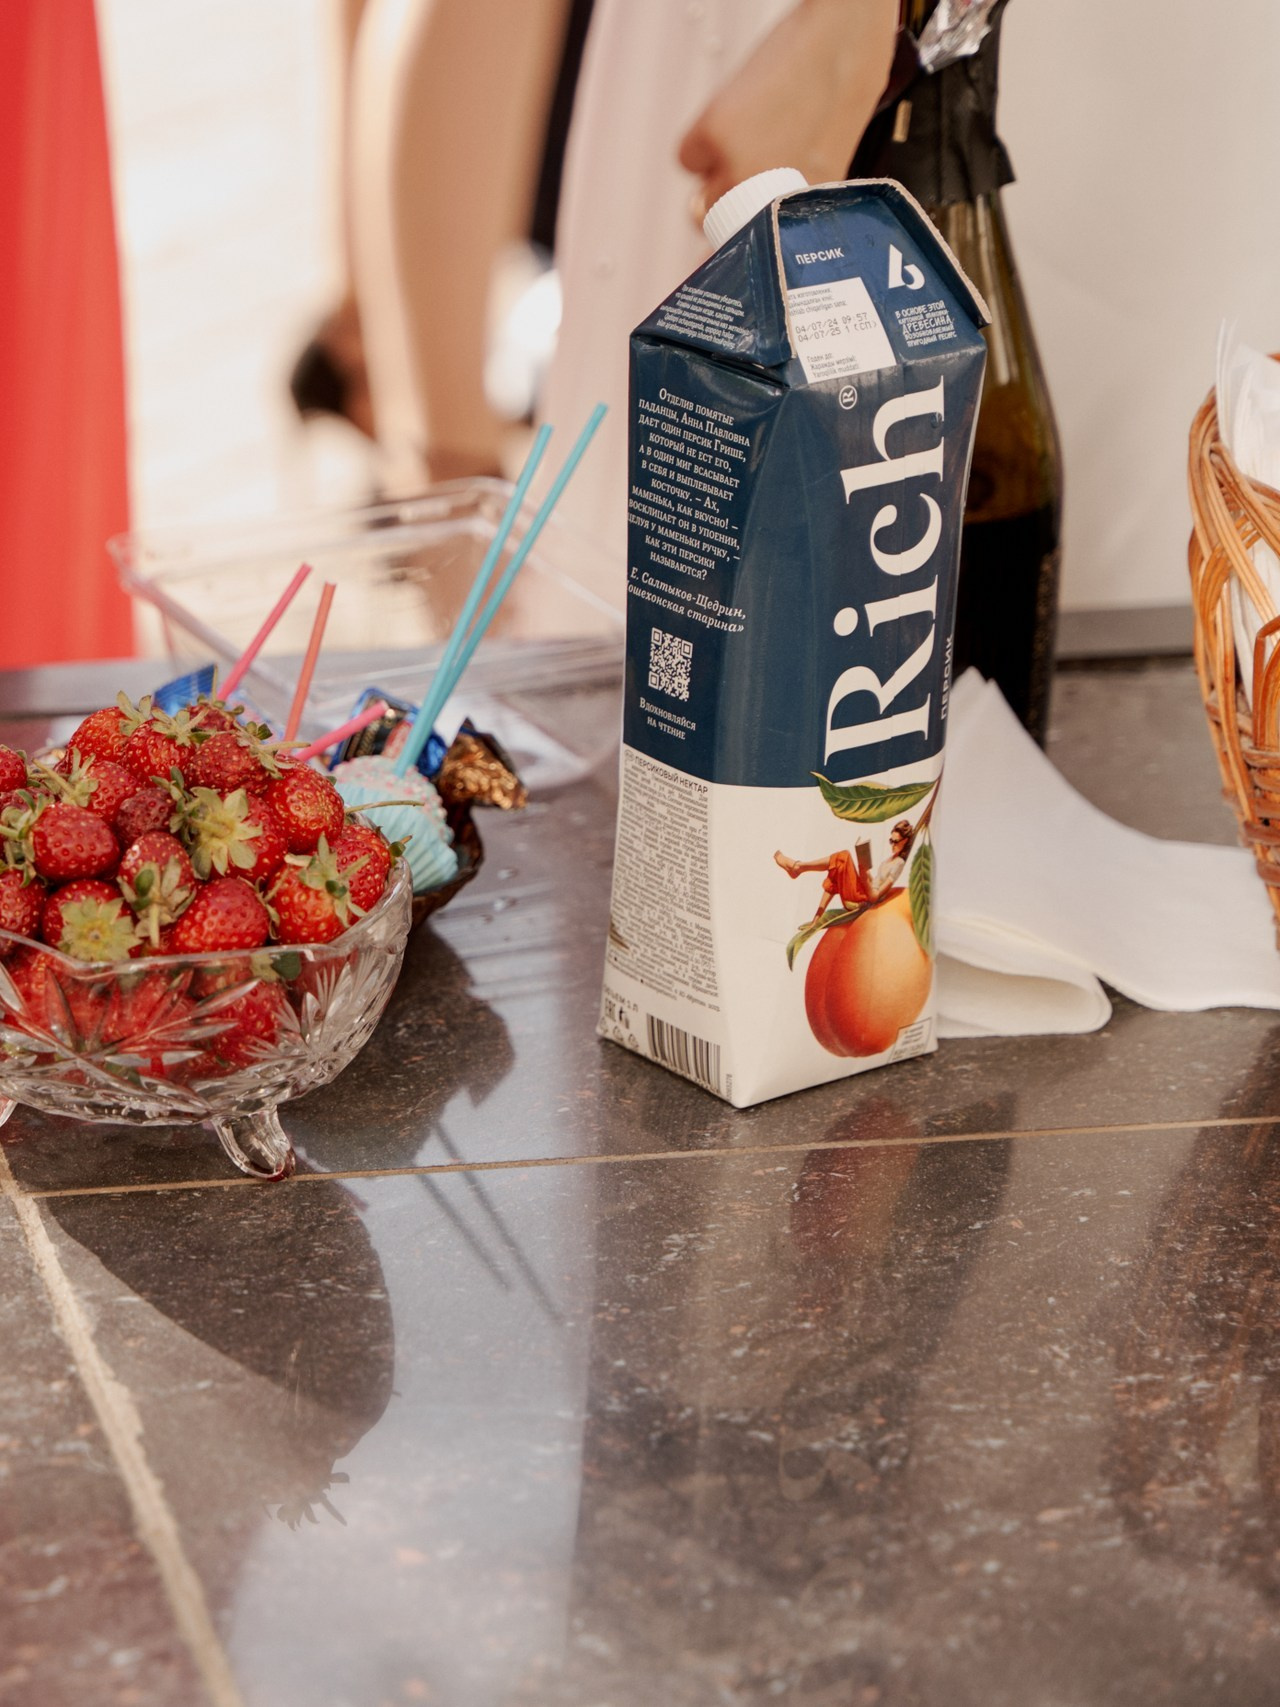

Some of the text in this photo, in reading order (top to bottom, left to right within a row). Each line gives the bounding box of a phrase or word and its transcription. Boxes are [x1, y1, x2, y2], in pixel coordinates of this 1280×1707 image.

[795, 247, 845, 265] ПЕРСИК
[895, 300, 946, 319] В ОСНОВЕ ЭТОЙ
[795, 318, 838, 334] 04/07/24
[798, 327, 841, 342] 04/07/25
[659, 388, 734, 426] ОТДЕЛИВ ПОМЯТЫЕ
[638, 414, 659, 428] ДАЕТ
[661, 422, 681, 436] ОДИН
[682, 431, 712, 449] ПЕРСИК
[681, 412, 703, 431] АННА
[705, 420, 750, 447] ПАВЛОВНА
[649, 432, 685, 454] КОТОРЫЙ
[686, 447, 696, 457] НЕ
[698, 452, 713, 464] ЕСТ
[639, 444, 645, 454] А
[653, 449, 675, 465] ОДИН
[675, 458, 692, 471] МИГ
[693, 464, 740, 488] ВСАСЫВАЕТ
[648, 462, 667, 477] СЕБЯ
[628, 498, 677, 525] ВОСКЛИЦАЕТ
[678, 519, 690, 530] ОН
[676, 503, 693, 517] КАК
[645, 534, 716, 570] КАК ЭТИ ПЕРСИКИ
[657, 525, 701, 550] МАМЕНЬКИ
[824, 375, 945, 766] Rich
[641, 571, 747, 620] Салтыков-Щедрин,
[687, 609, 745, 633] старина»
[647, 715, 686, 740] НА ЧТЕНИЕ
[635, 755, 680, 783] ПЕРСИКОВЫЙ
[679, 779, 708, 795] НЕКТАР
